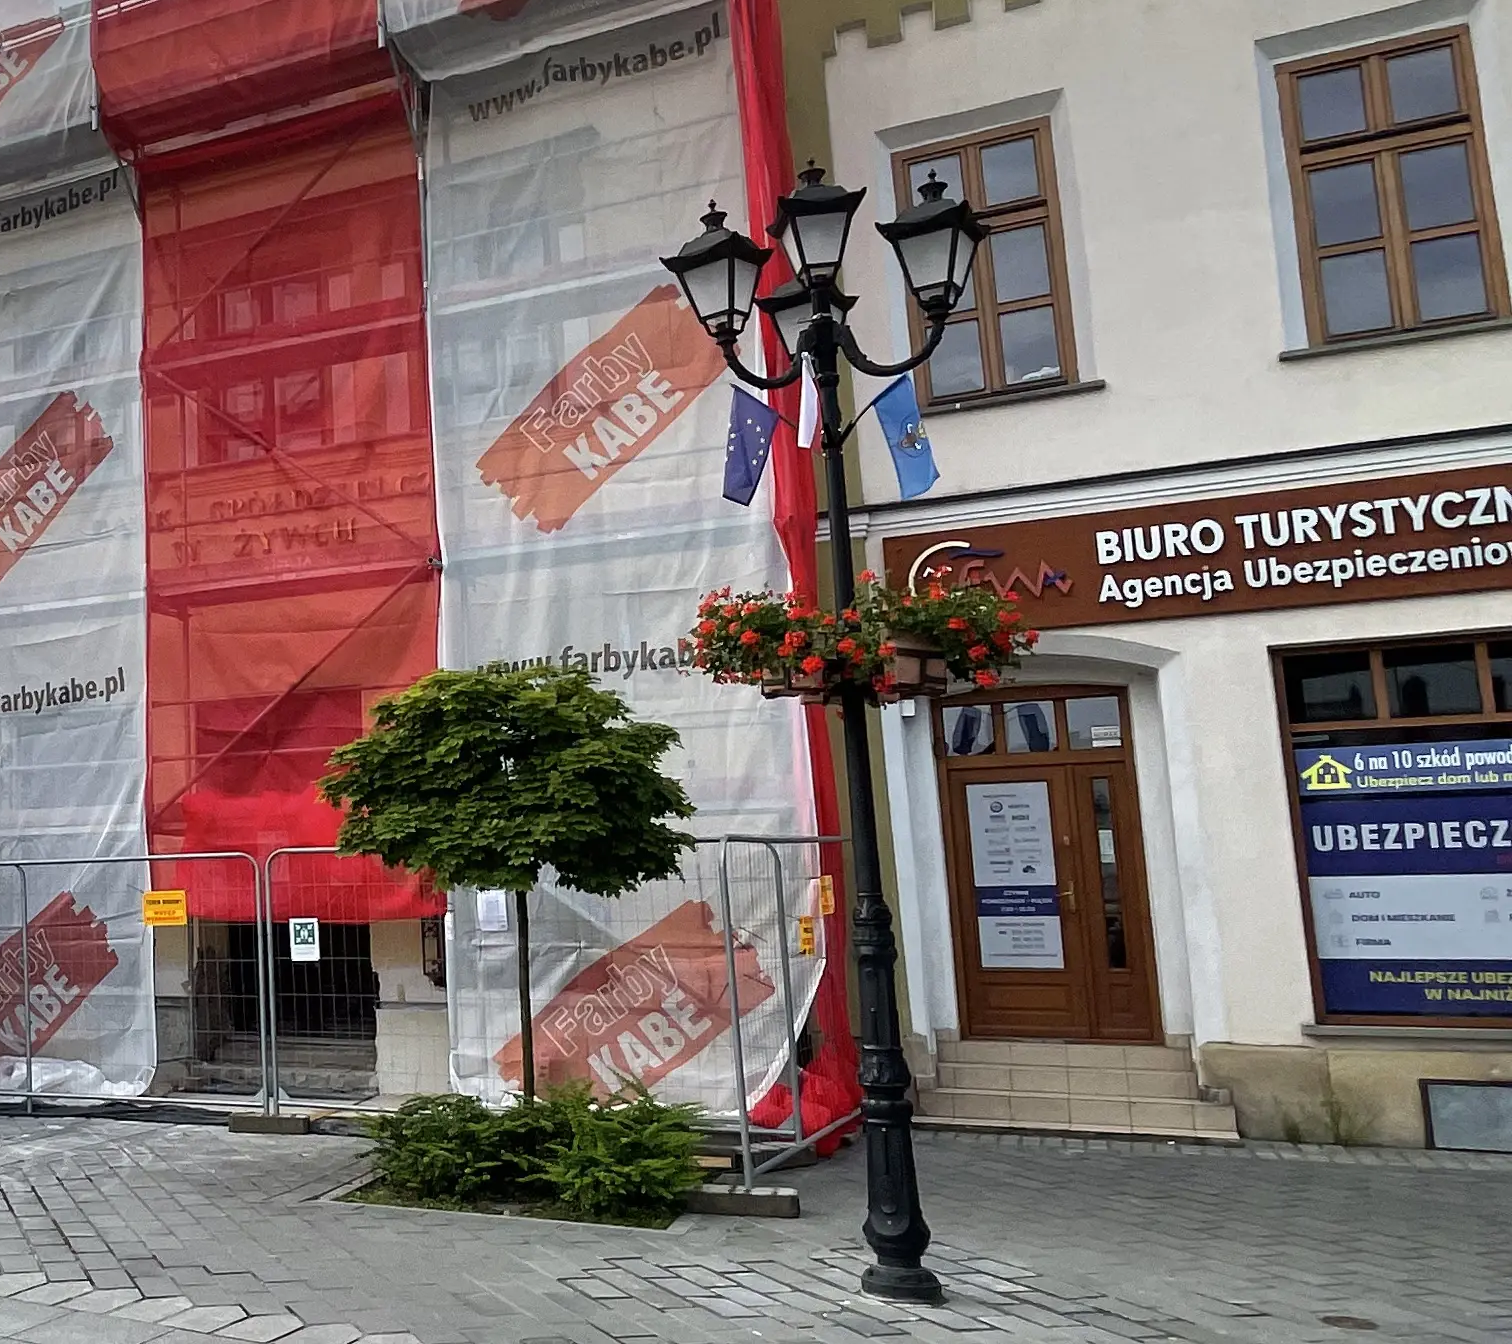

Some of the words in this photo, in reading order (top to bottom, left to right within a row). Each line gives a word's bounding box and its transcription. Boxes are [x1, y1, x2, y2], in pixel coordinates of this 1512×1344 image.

[468, 12, 721, 122] www.farbykabe.pl
[520, 332, 654, 453] Farby
[562, 370, 684, 480] KABE
[1095, 518, 1225, 565] BIURO
[1099, 565, 1234, 608] Agencja
[1354, 752, 1365, 771] 6
[1368, 756, 1388, 770] na
[1392, 750, 1412, 769] 10
[1416, 746, 1461, 767] szkód
[1356, 775, 1434, 789] Ubezpiecz
[1438, 772, 1471, 785] dom
[1474, 770, 1499, 783] lub
[1311, 820, 1512, 852] UBEZPIECZ
[1349, 891, 1381, 899] AUTO
[1369, 971, 1468, 984] NAJLEPSZE
[1425, 988, 1442, 1000] W
[540, 944, 678, 1056] Farby
[587, 991, 712, 1094] KABE
